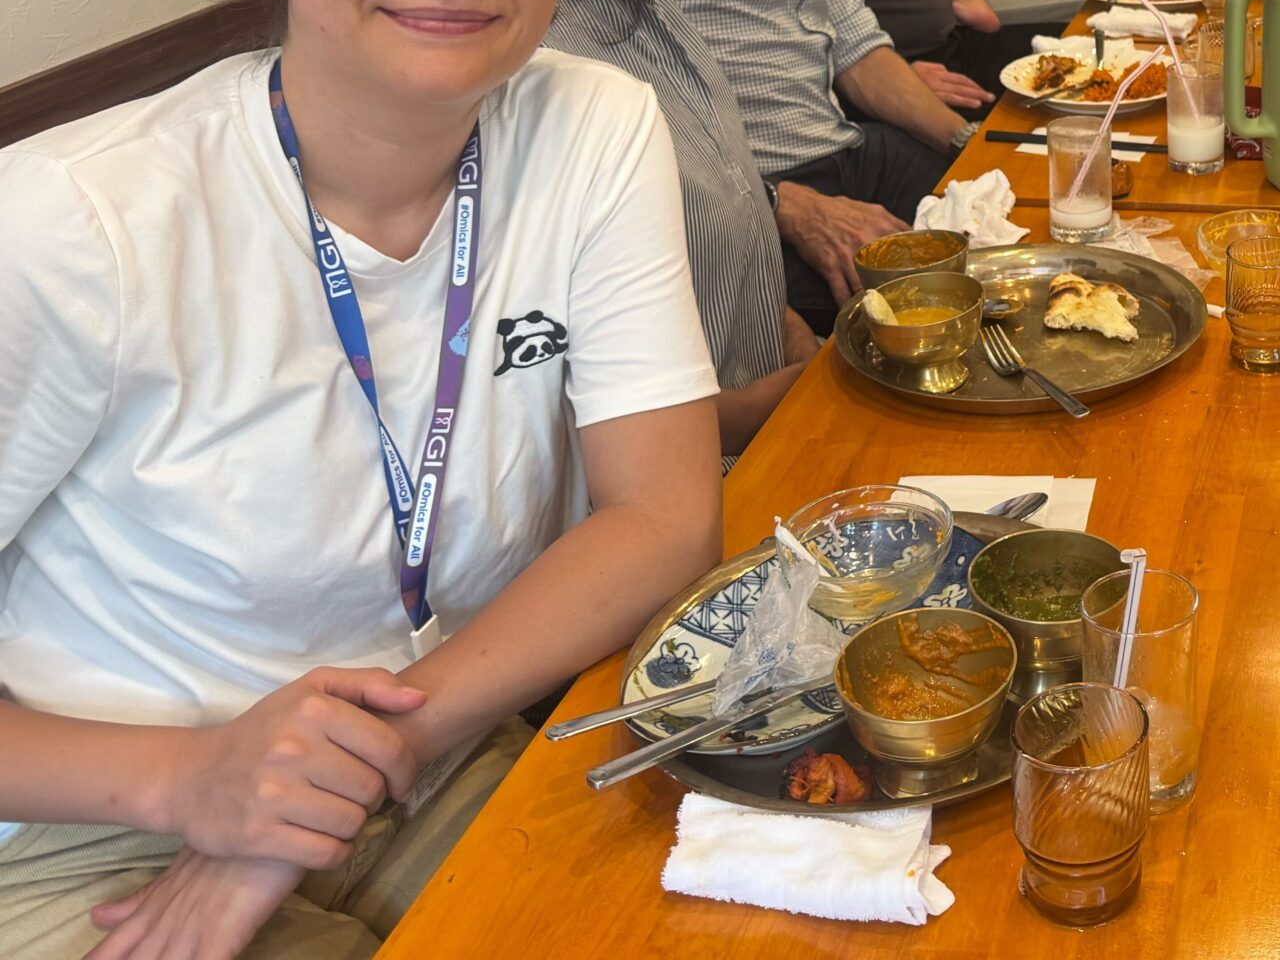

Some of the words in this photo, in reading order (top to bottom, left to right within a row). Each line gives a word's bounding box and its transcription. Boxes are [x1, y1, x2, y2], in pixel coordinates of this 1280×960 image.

[458, 203, 470, 243] #Omics
[457, 245, 468, 261] for
[317, 237, 352, 298] MGI
[455, 263, 466, 278] All
[424, 408, 454, 467] MGI
[388, 446, 400, 464] for
[393, 466, 411, 504] #Omics
[416, 481, 432, 523] #Omics
[414, 526, 425, 542] for
[410, 545, 421, 559] All
